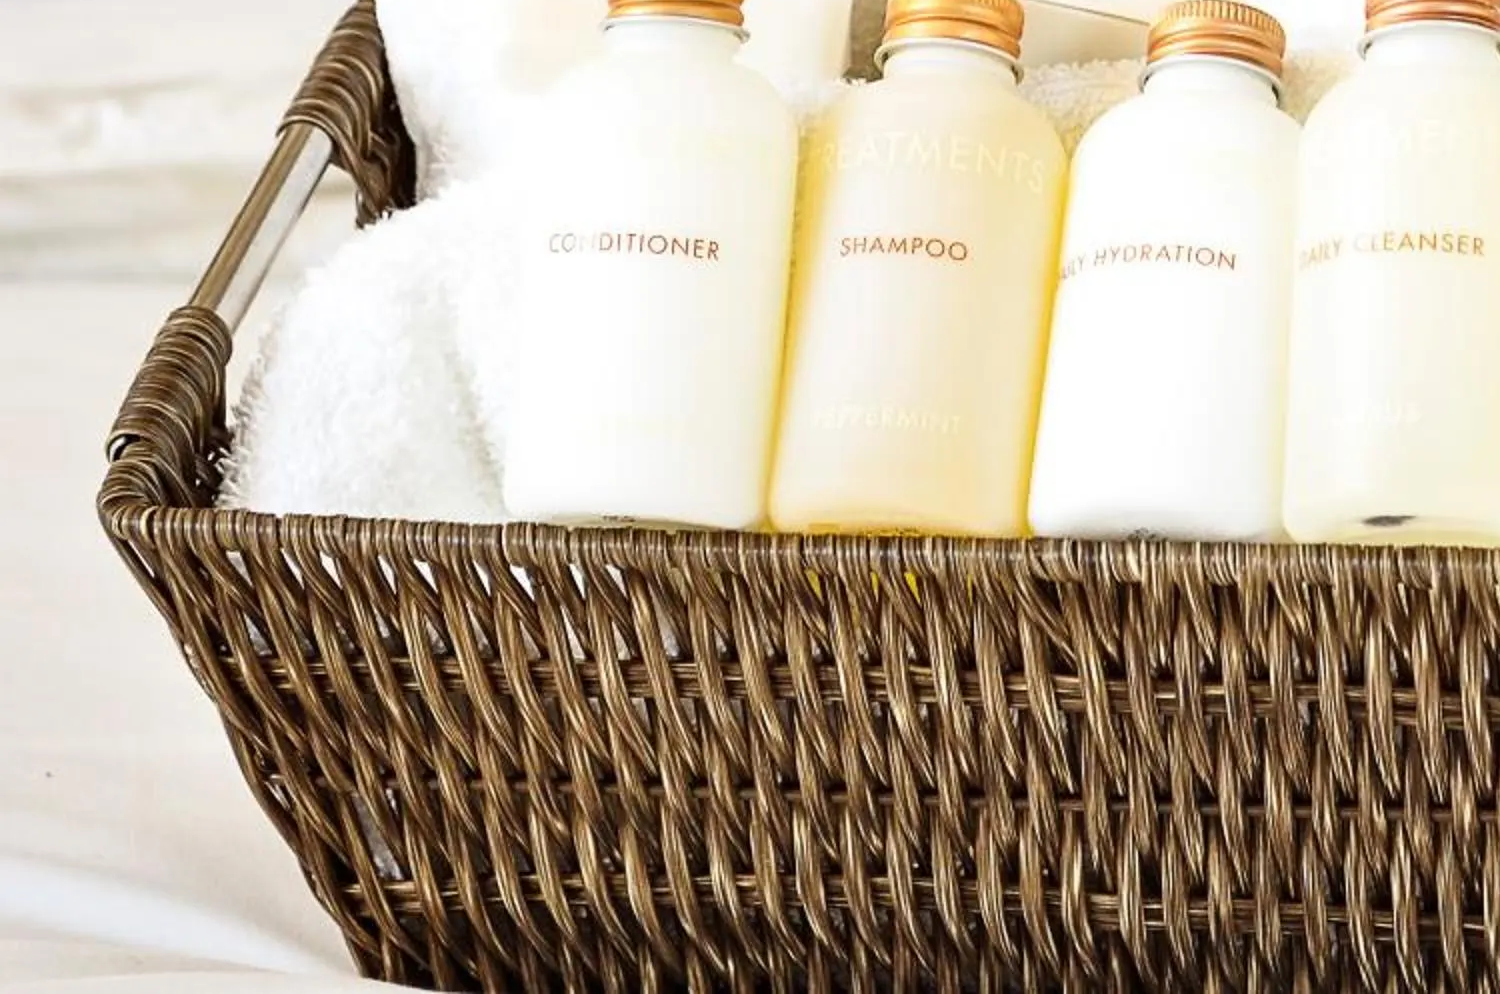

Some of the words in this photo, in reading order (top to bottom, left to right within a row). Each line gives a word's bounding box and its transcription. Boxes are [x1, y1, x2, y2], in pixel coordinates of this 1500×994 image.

[822, 130, 1044, 195] REATMENTS
[548, 232, 719, 262] CONDITIONER
[839, 235, 968, 262] SHAMPOO
[1093, 243, 1236, 271] HYDRATION
[1353, 230, 1486, 258] CLEANSER
